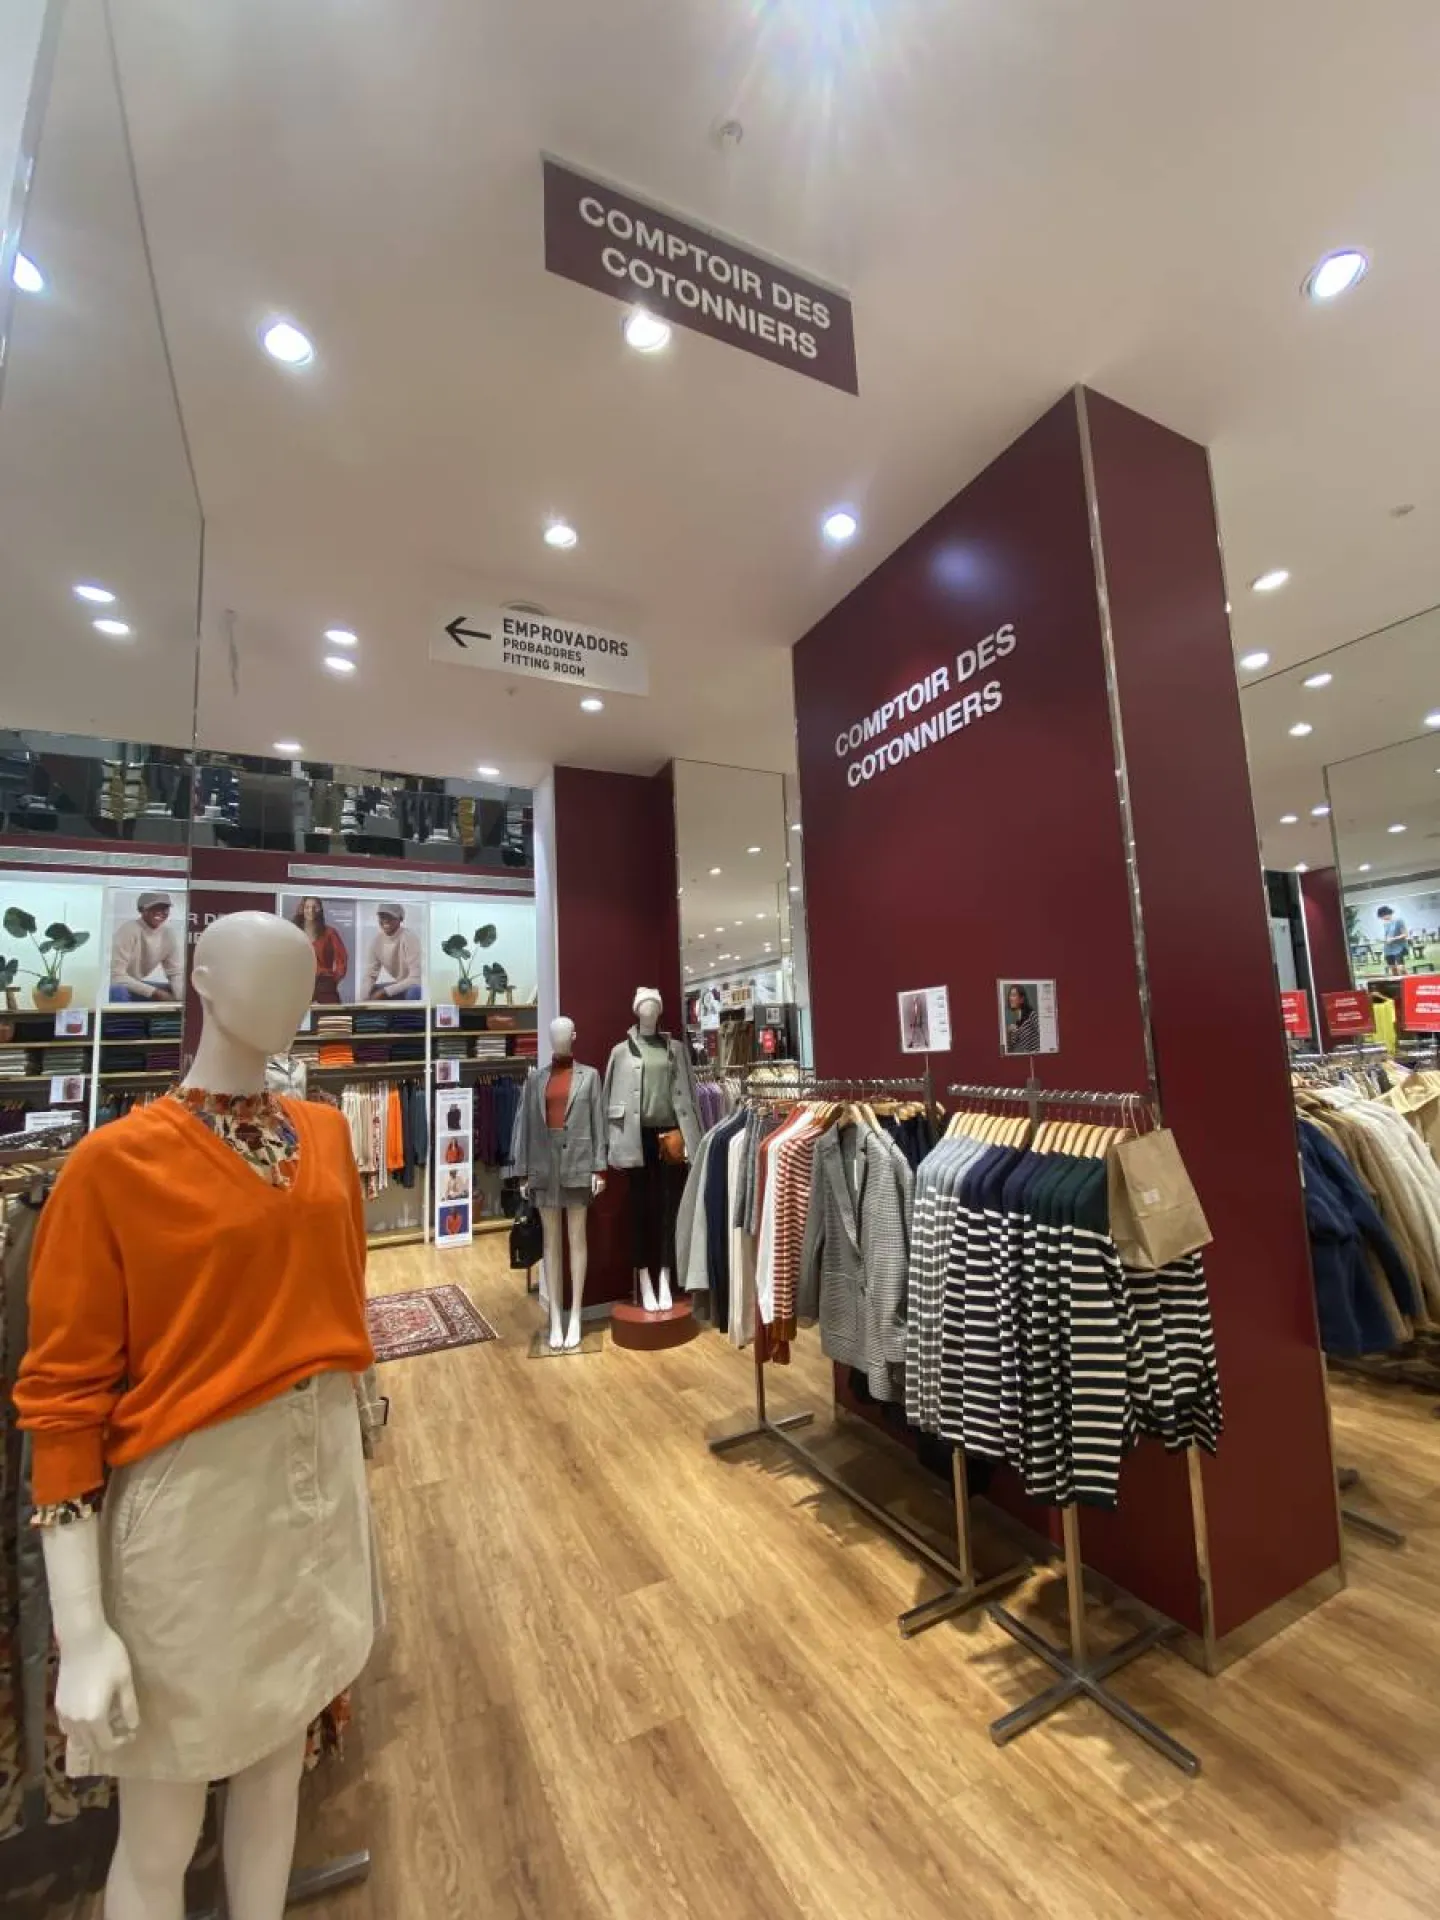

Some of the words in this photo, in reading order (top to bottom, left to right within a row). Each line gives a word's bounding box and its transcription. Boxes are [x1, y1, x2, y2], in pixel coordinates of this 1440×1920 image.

[579, 197, 763, 299] COMPTOIR
[771, 281, 831, 330] DES
[601, 247, 818, 359] COTONNIERS
[503, 618, 628, 657] EMPROVADORS
[503, 638, 582, 662] PROBADORES
[503, 652, 550, 671] FITTING
[553, 660, 585, 677] ROOM
[835, 666, 951, 757] COMPTOIR
[956, 623, 1017, 683] DES
[847, 680, 1003, 788] COTONNIERS
